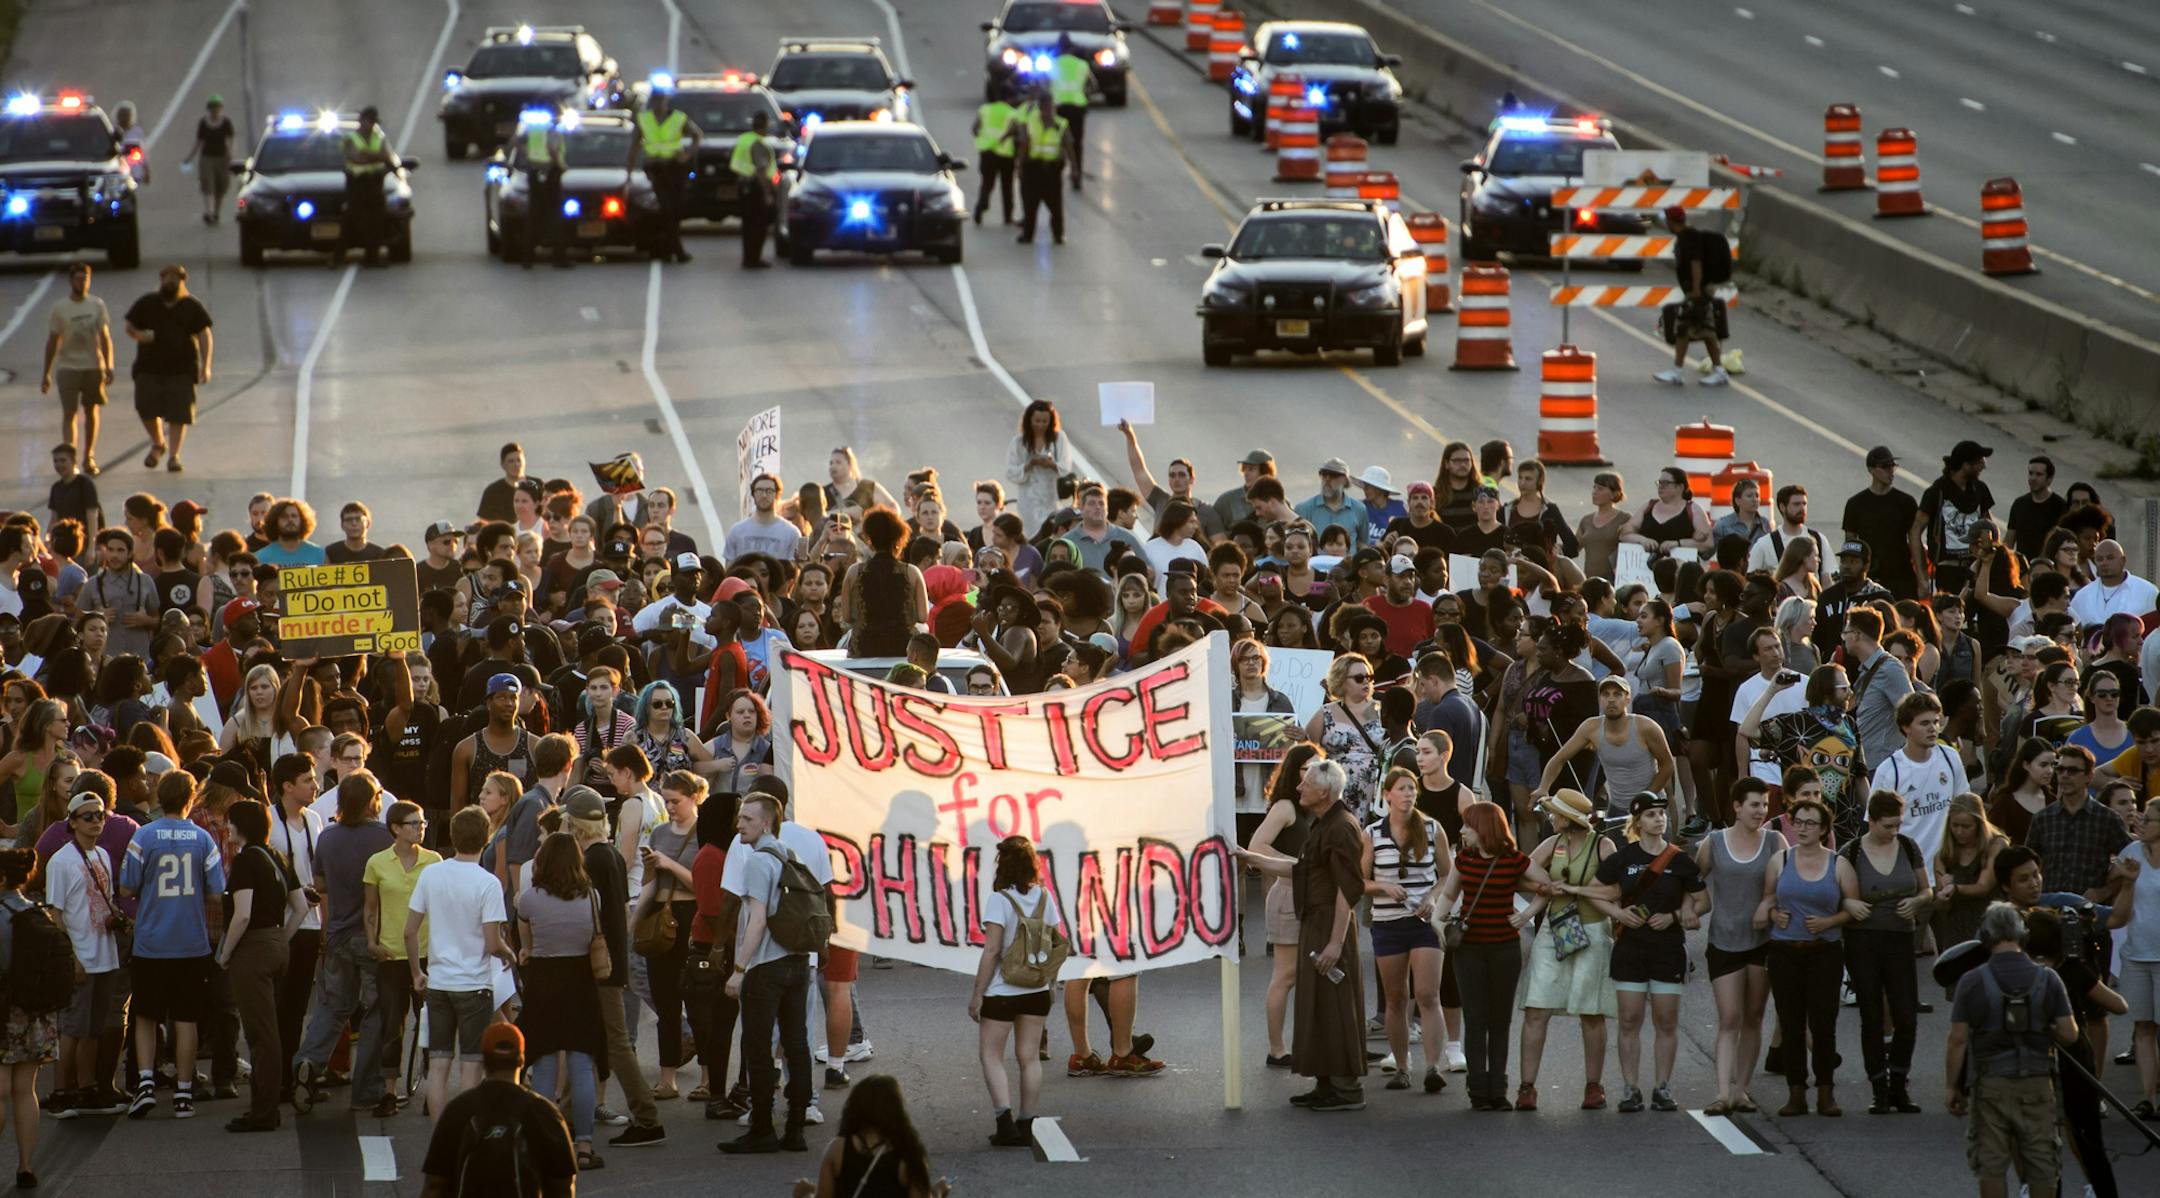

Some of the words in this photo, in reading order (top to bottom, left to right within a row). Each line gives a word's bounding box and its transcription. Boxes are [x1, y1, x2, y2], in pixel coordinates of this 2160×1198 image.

[283, 567, 328, 588] Rule
[334, 567, 346, 584] #
[352, 565, 365, 584] 6
[343, 588, 382, 609] not
[377, 632, 420, 650] God
[780, 651, 1208, 777] JUSTICE
[937, 772, 1064, 848] for
[1910, 798, 1952, 817] Emira
[158, 852, 195, 897] 21
